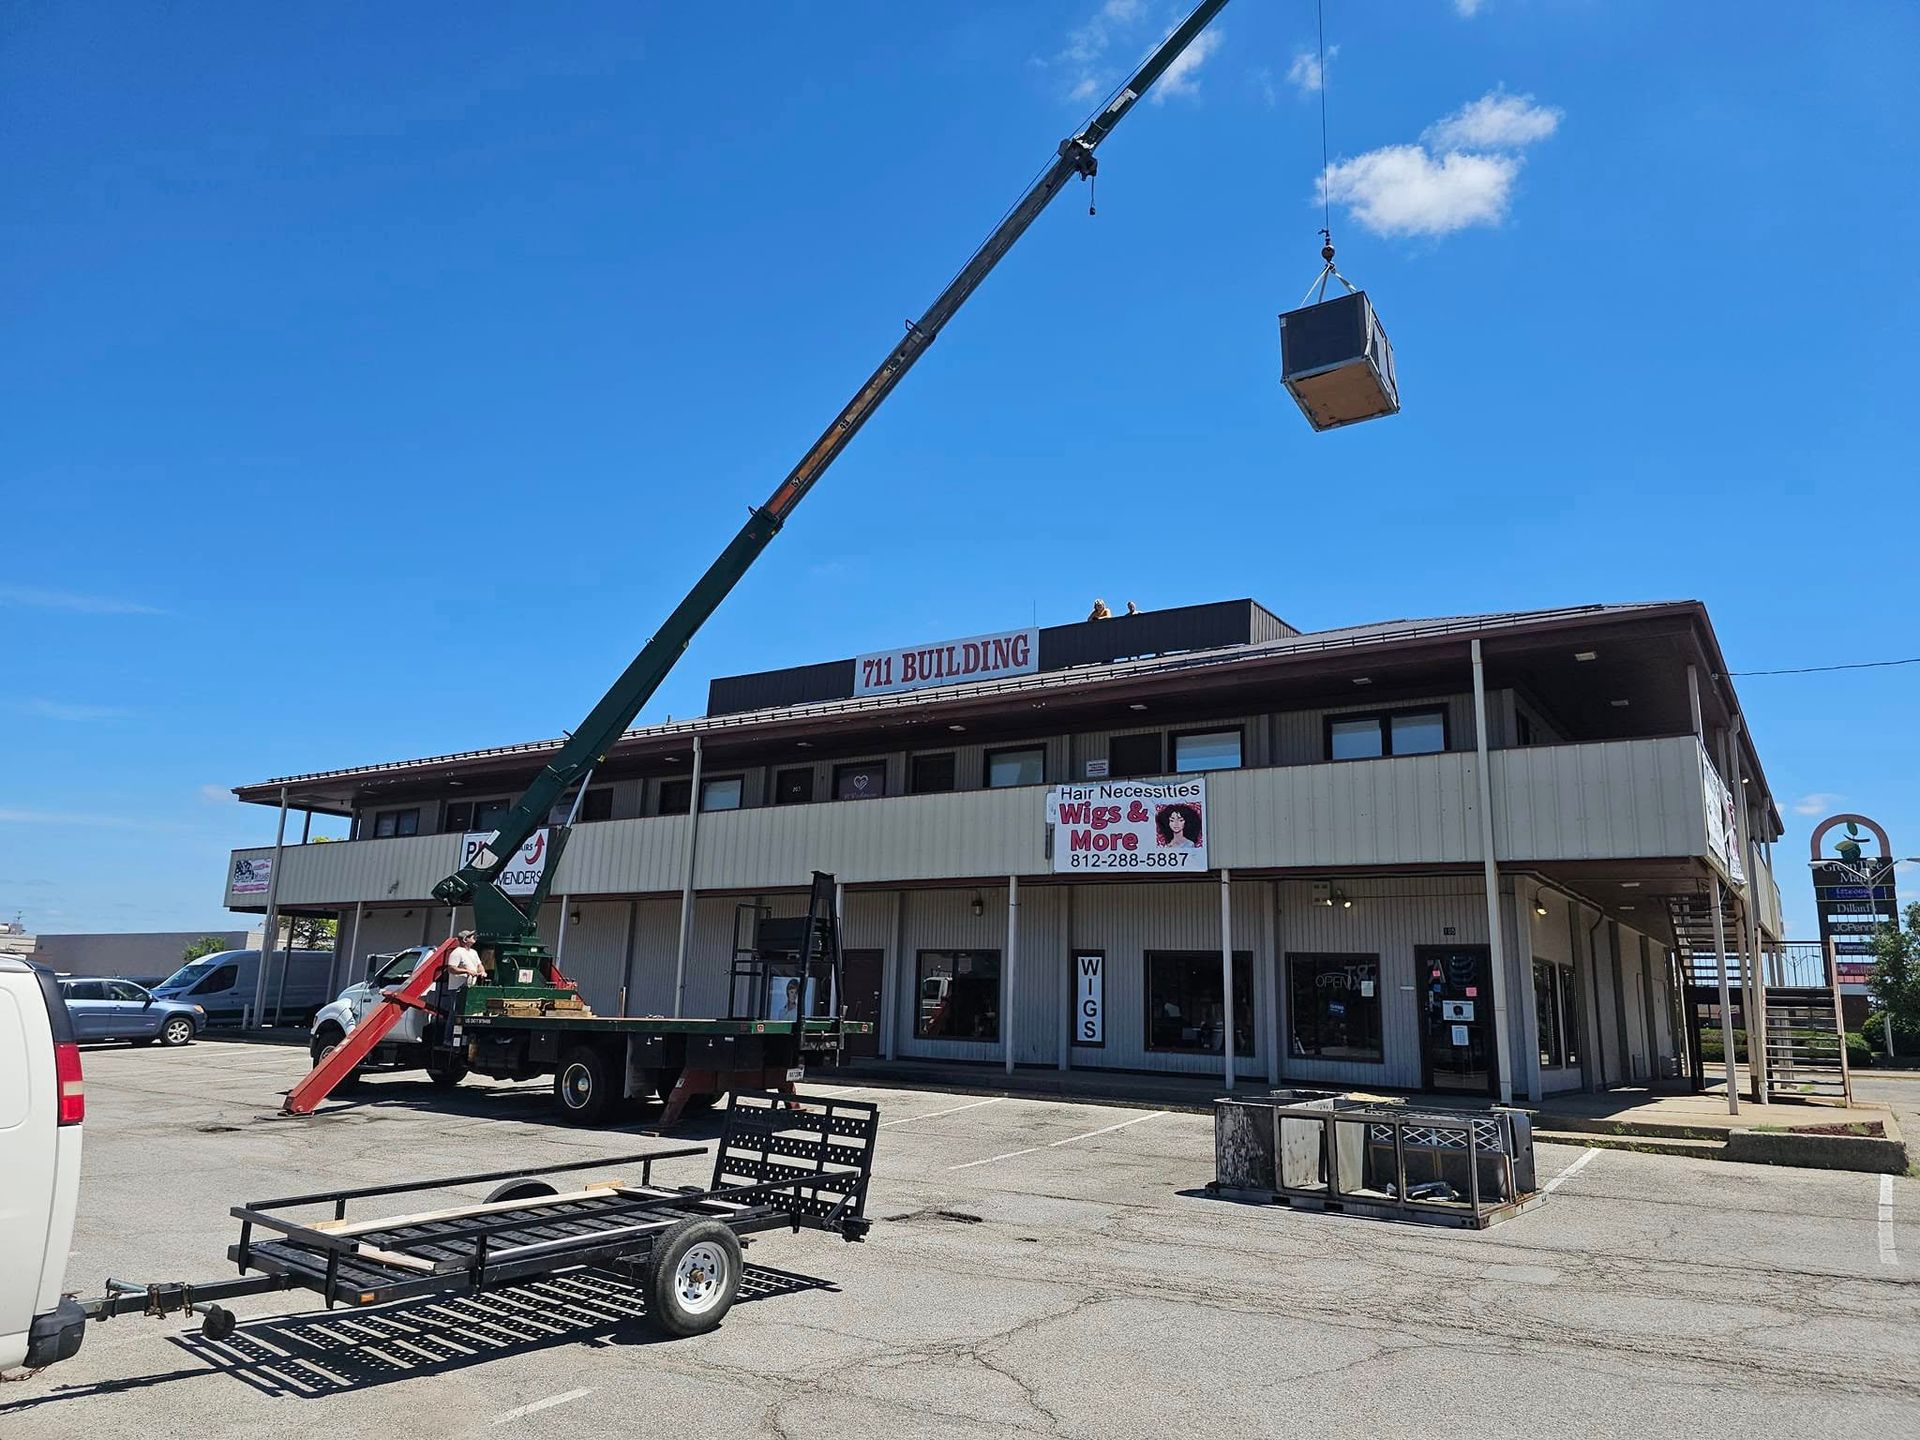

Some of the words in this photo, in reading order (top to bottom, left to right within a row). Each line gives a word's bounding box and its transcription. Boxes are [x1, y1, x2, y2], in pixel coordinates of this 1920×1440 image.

[863, 657, 892, 688] 711
[901, 634, 1030, 683] BUILDING
[1061, 787, 1094, 800] Hair
[1100, 784, 1200, 800] Necessities
[1059, 801, 1122, 830] Wigs
[1126, 800, 1149, 823] &
[1070, 830, 1139, 851] More
[1070, 853, 1188, 867] 812-288-5887
[1822, 862, 1857, 872] Gren
[497, 870, 542, 885] MENDERS
[1315, 975, 1350, 990] OPEN
[1081, 959, 1100, 1039] WIGS
